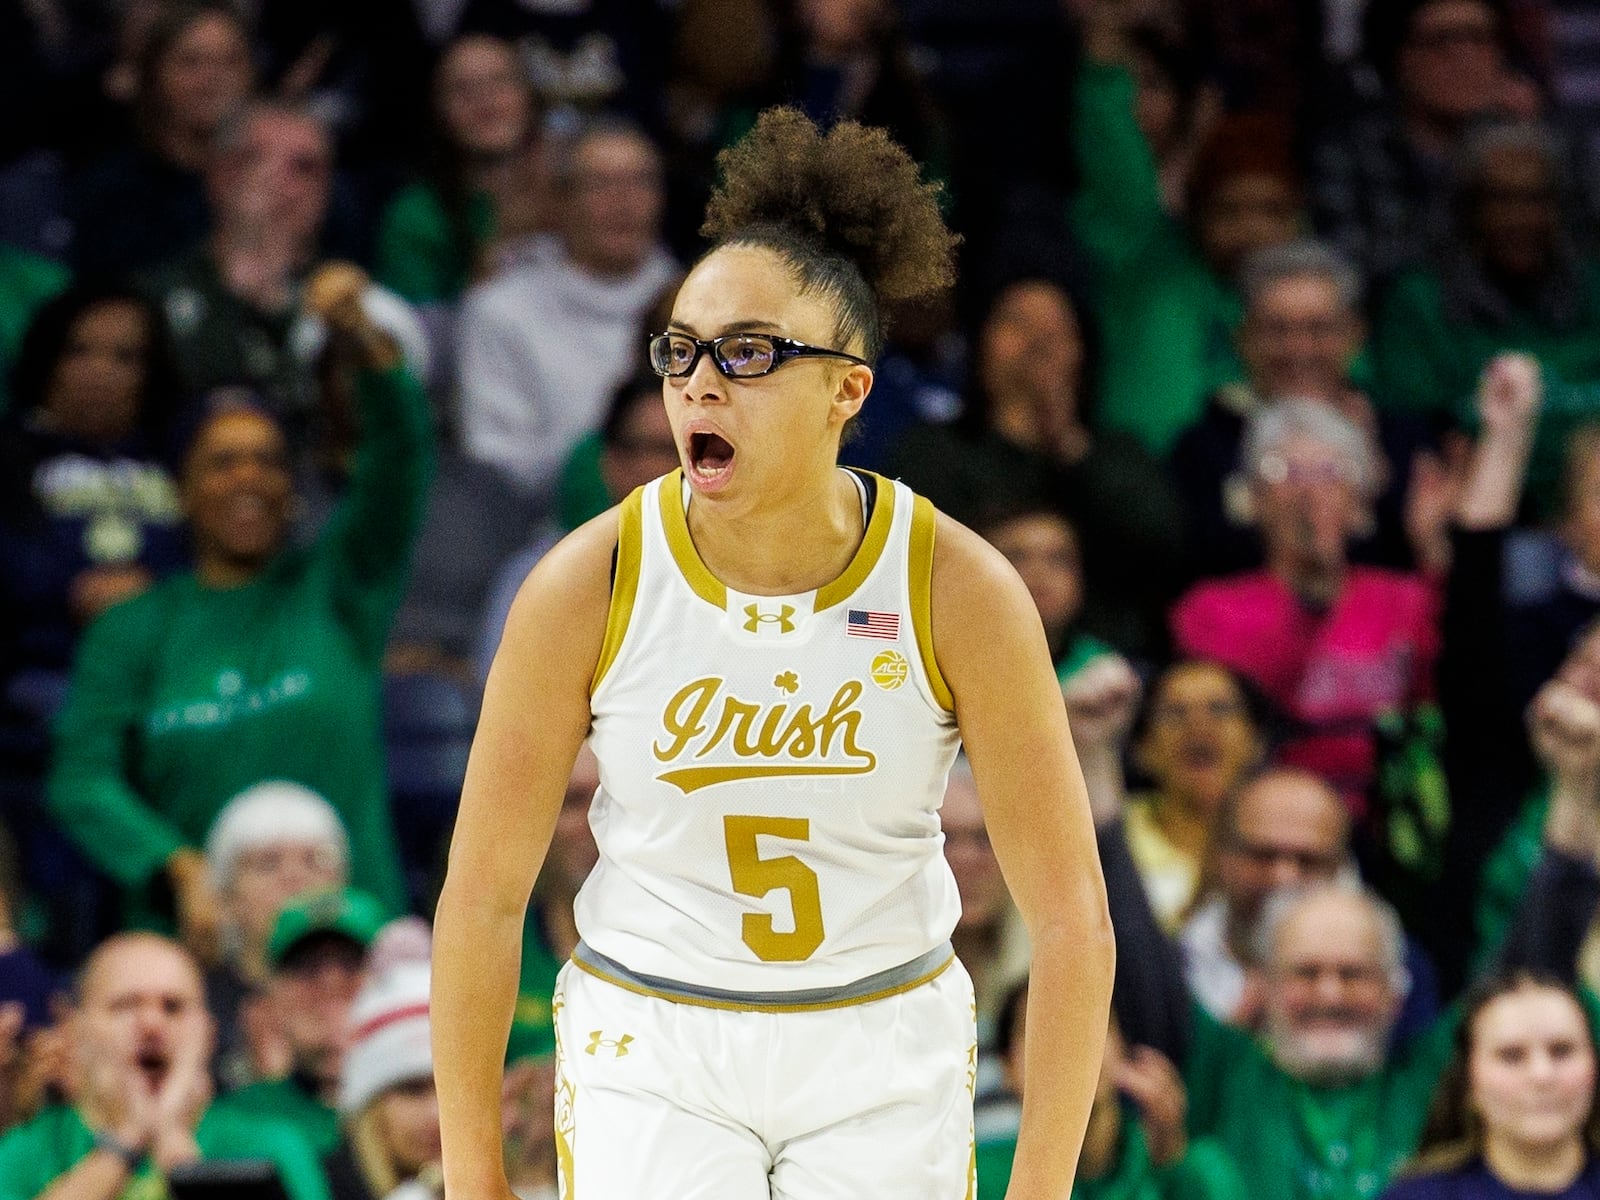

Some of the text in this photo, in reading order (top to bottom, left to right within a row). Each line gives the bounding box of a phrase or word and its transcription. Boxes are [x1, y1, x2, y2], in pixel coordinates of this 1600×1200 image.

[874, 662, 908, 673] ACC
[653, 676, 877, 780] Irish
[723, 815, 825, 962] 5
